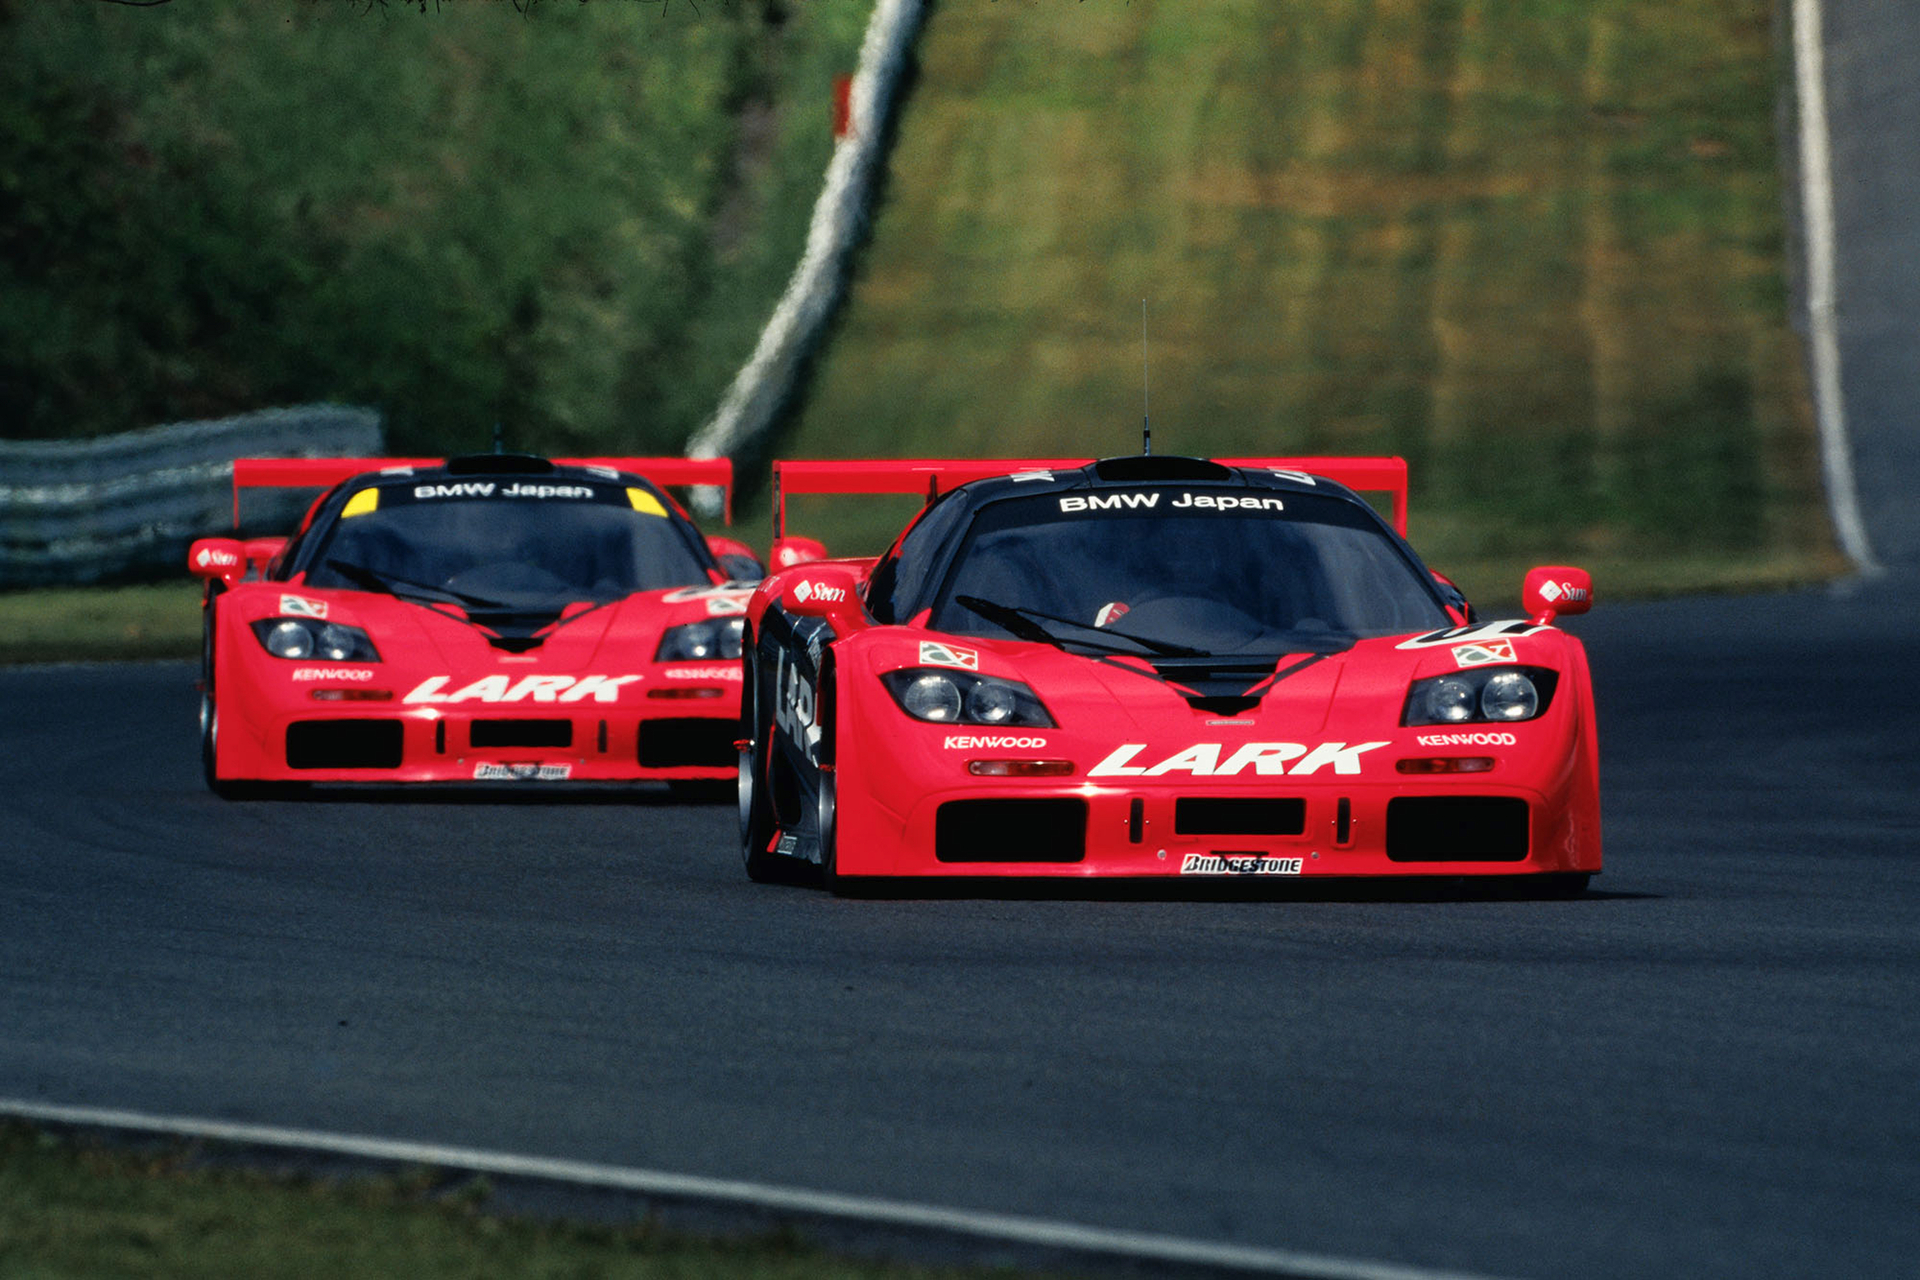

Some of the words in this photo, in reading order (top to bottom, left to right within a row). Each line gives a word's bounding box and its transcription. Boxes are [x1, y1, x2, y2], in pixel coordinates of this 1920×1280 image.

[414, 483, 496, 498] BMW
[502, 483, 594, 498] Japan
[1059, 493, 1159, 513] BMW
[1172, 493, 1284, 511] Japan
[810, 582, 846, 602] Sun
[1561, 582, 1587, 602] Sun
[292, 667, 374, 682] KENWOOD
[402, 674, 644, 704] LARK
[776, 646, 823, 768] LAR
[944, 736, 1047, 749] KENWOOD
[1417, 732, 1517, 746] KENWOOD
[1087, 741, 1393, 776] LARK
[1182, 855, 1301, 873] BRIDGESTONE
